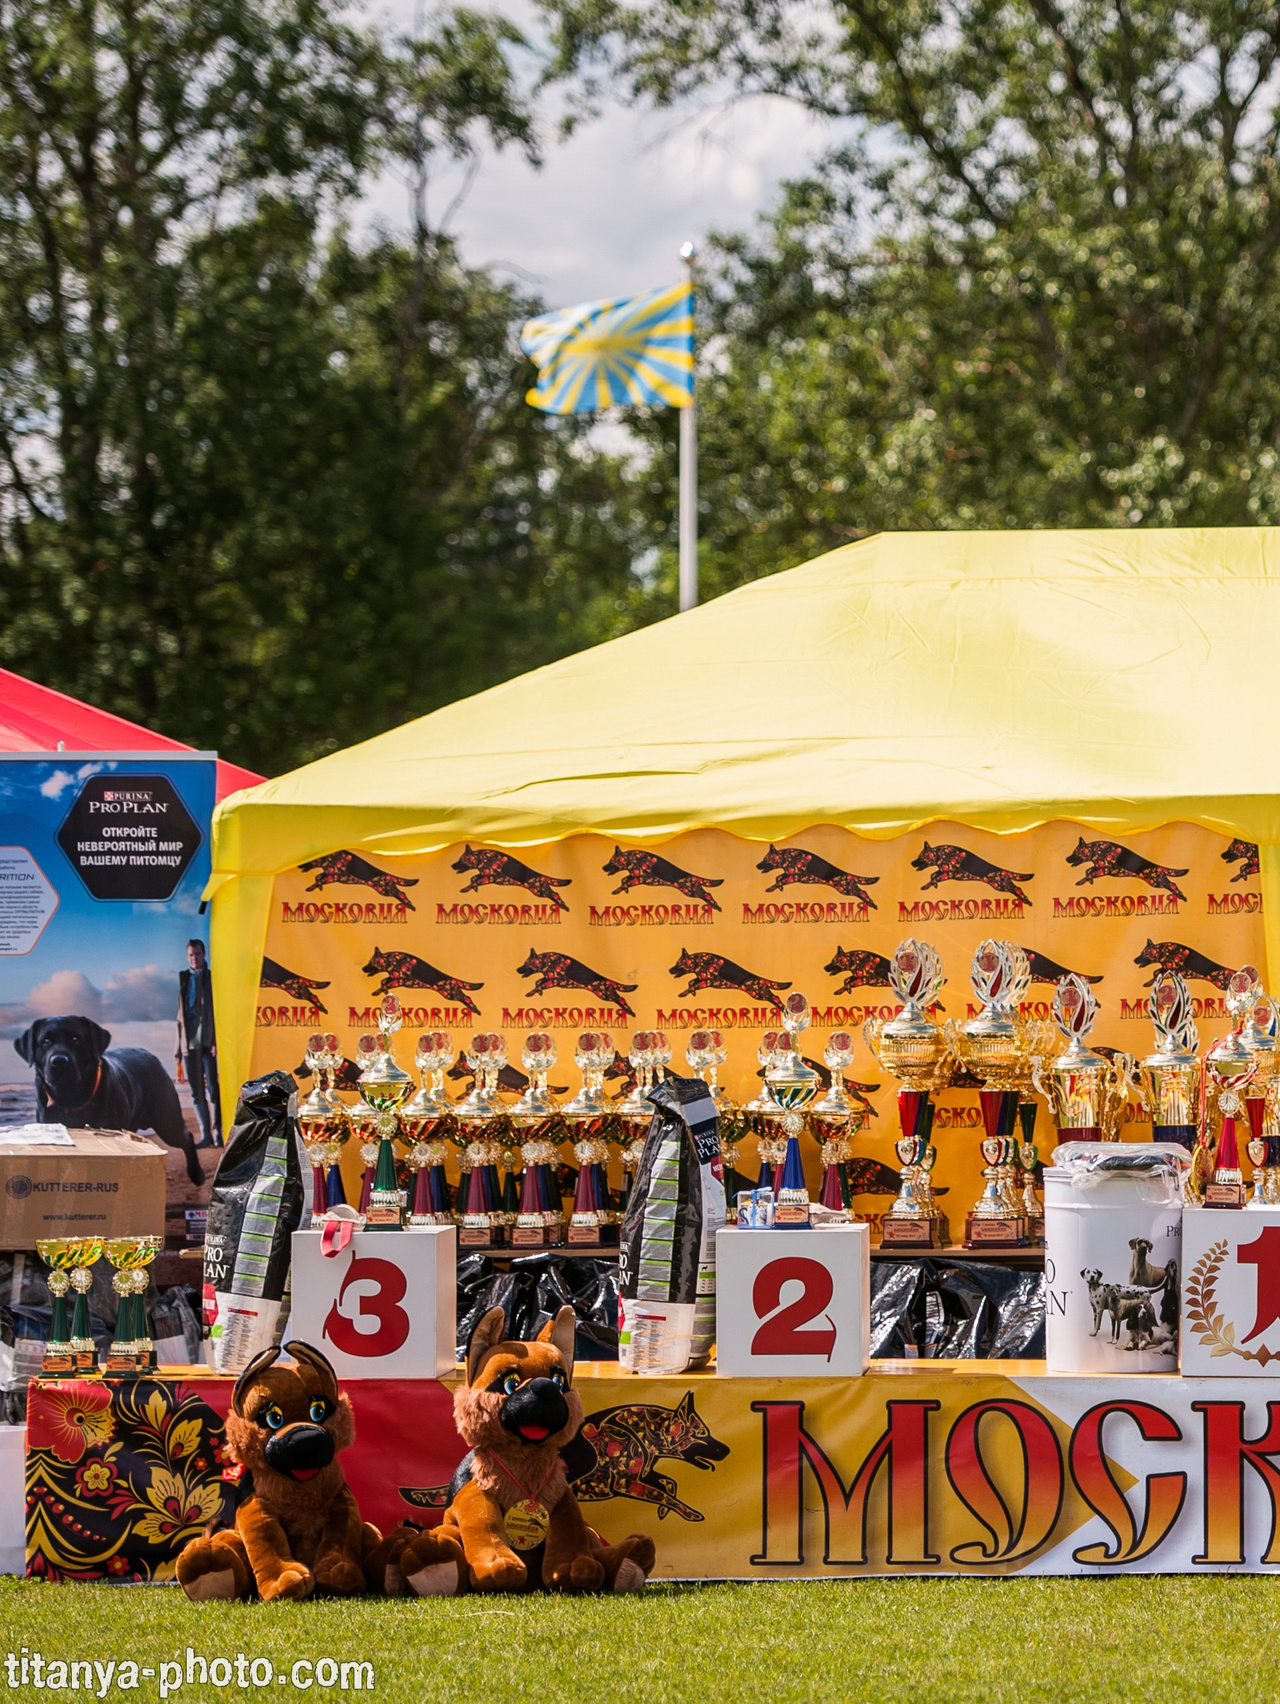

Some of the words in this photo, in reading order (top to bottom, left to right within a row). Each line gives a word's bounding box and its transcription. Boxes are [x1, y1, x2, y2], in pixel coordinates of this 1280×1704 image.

[114, 792, 149, 800] PURINA
[89, 802, 120, 813] PRO
[123, 802, 168, 813] PLAN
[102, 826, 158, 837] ОТКРОЙТЕ
[77, 840, 156, 851] НЕВЕРОЯТНЫЙ
[159, 842, 183, 851] МИР
[80, 856, 127, 866] ВАШЕМУ
[129, 856, 182, 867] ПИТОМЦУ
[698, 1136, 719, 1149] PRO
[698, 1144, 720, 1158] PLA
[33, 1183, 119, 1192] KUTTERER-RUS
[1166, 1225, 1182, 1237] PR
[204, 1262, 228, 1280] LAN
[322, 1250, 411, 1357] 3
[750, 1256, 838, 1363] 2
